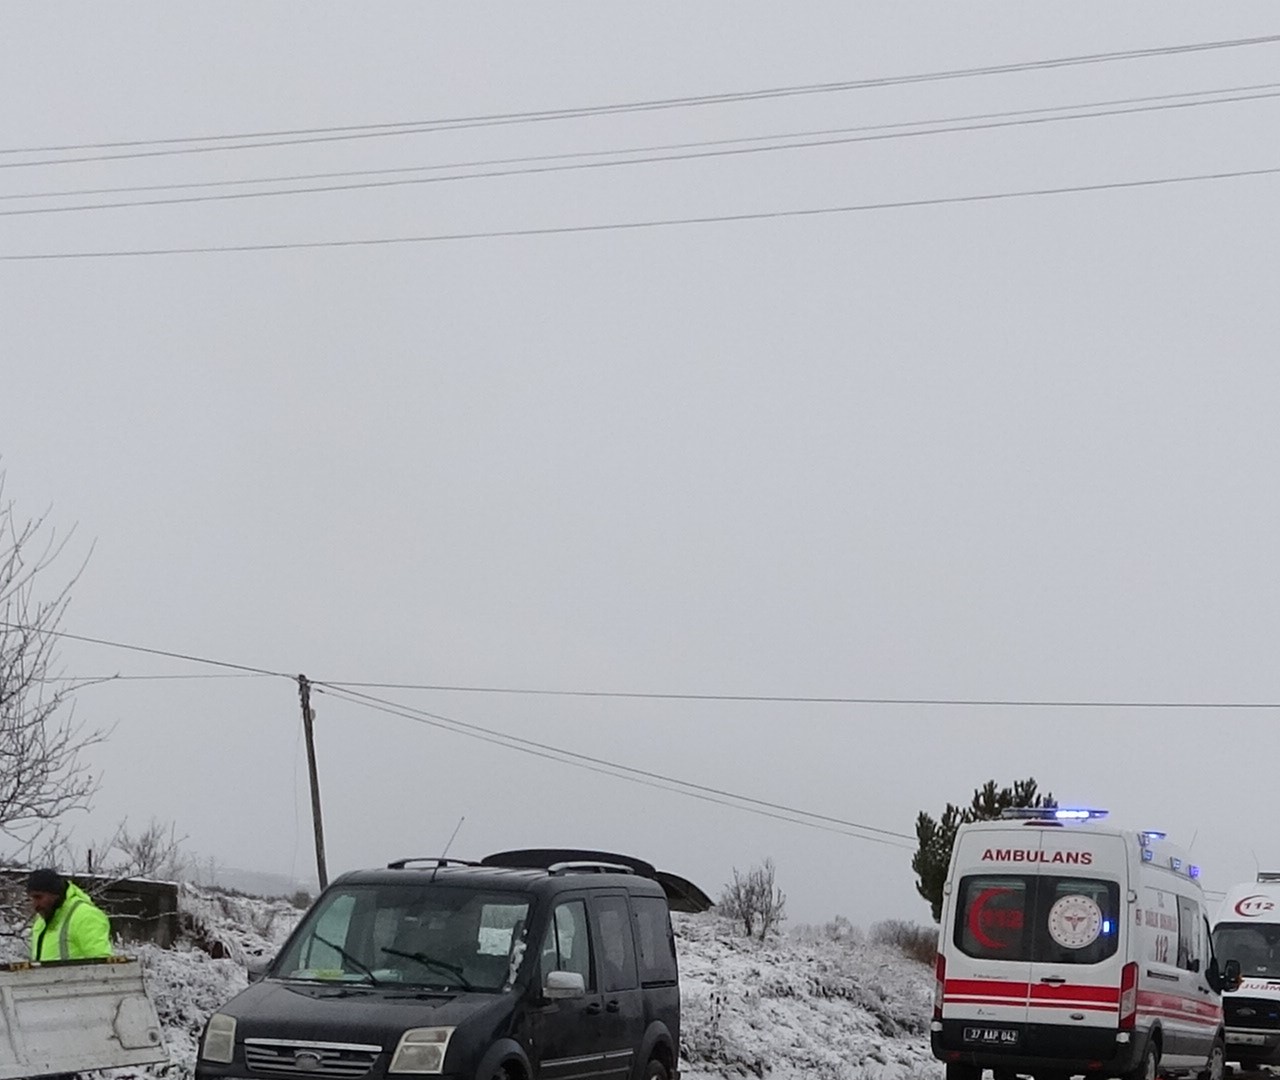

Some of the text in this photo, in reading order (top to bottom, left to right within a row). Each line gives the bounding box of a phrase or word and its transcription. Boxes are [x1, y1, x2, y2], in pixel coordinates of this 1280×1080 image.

[981, 849, 1093, 865] AMBULANS
[1244, 902, 1274, 911] 112
[1155, 934, 1168, 963] 112
